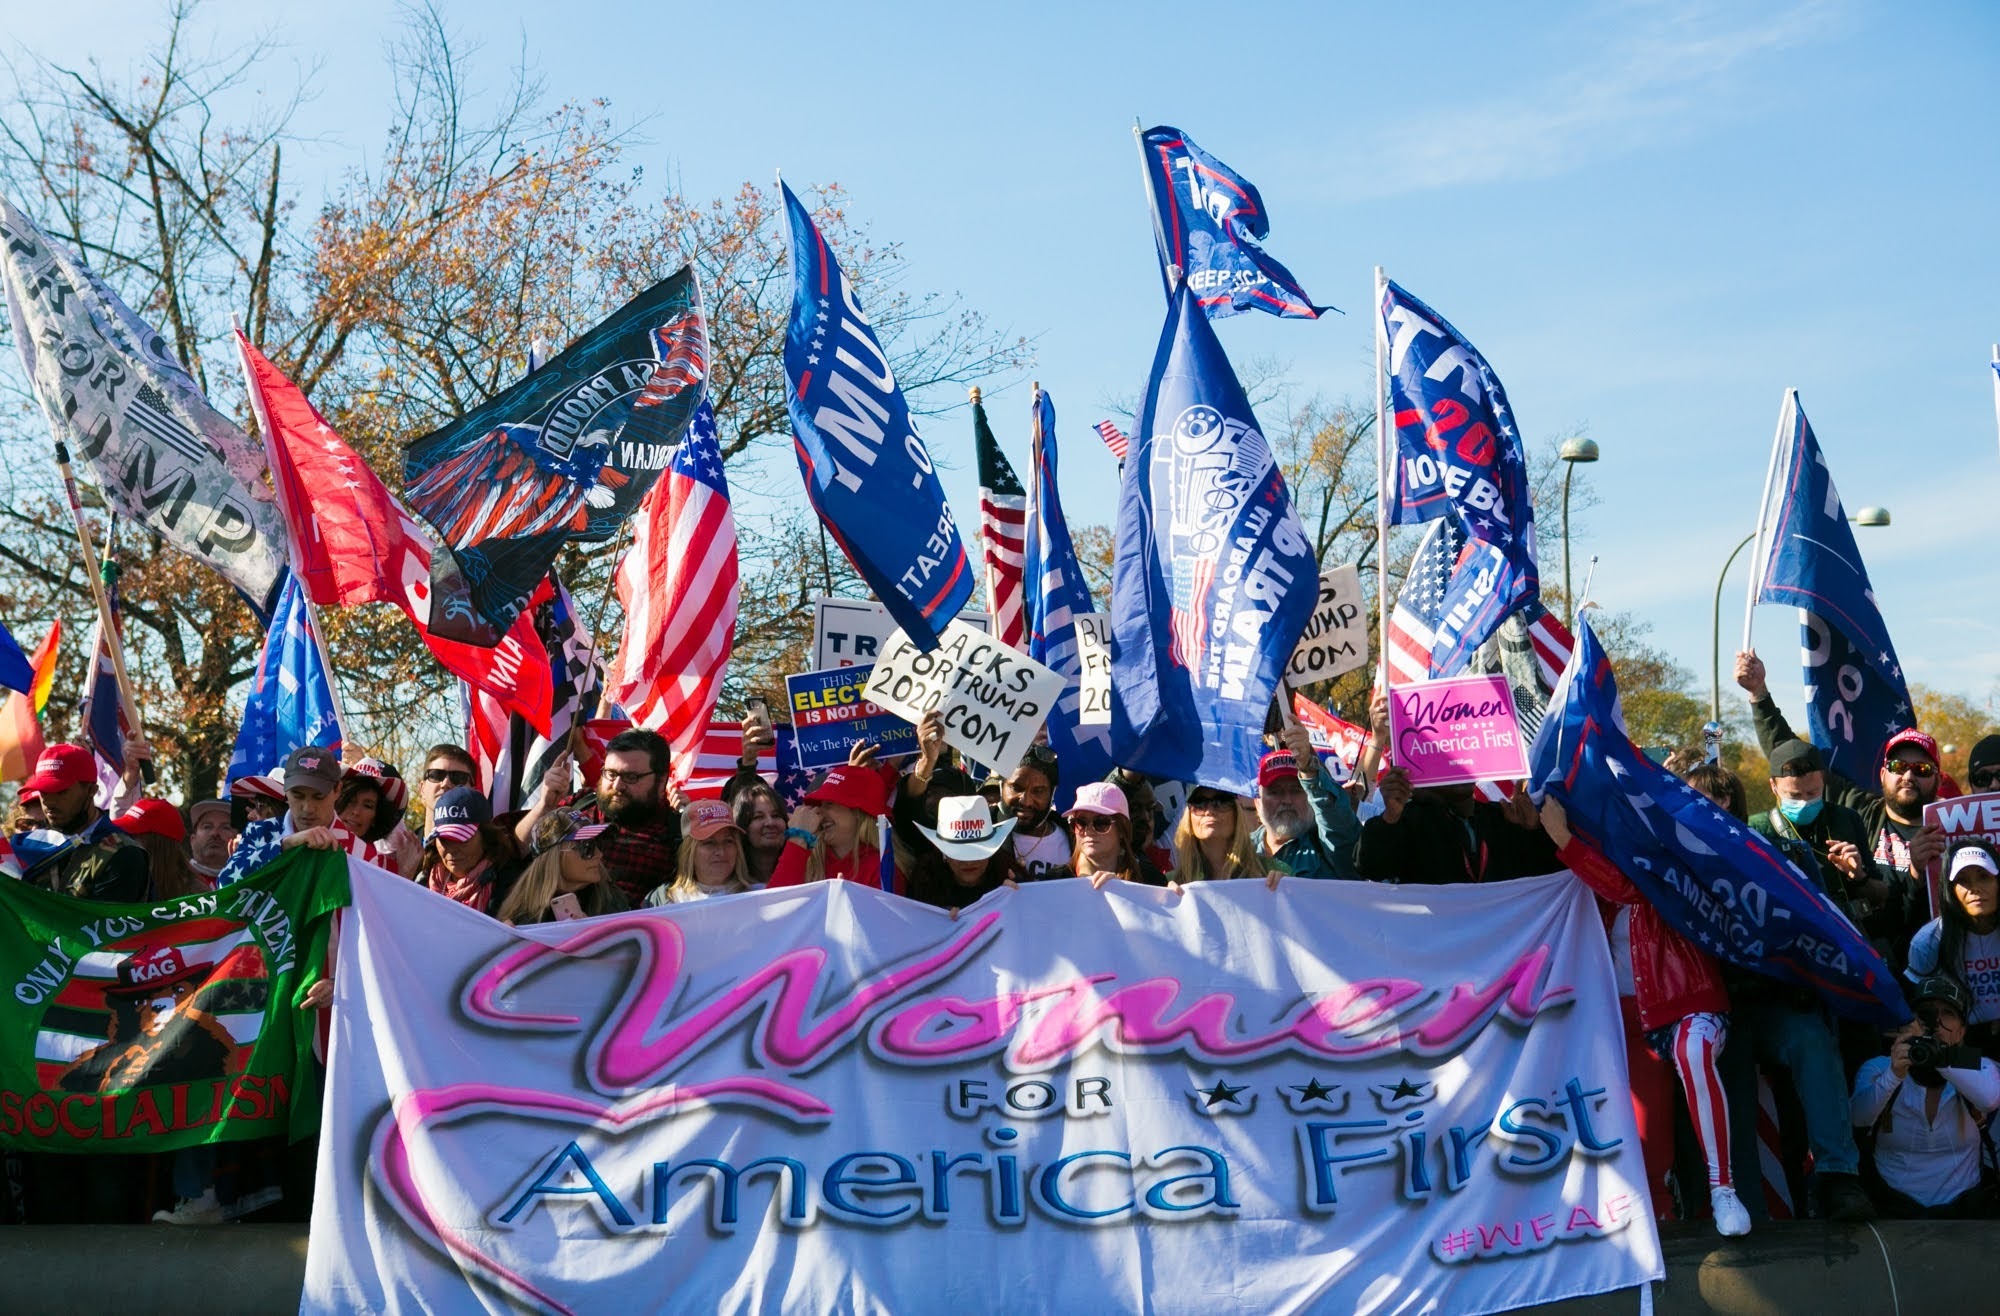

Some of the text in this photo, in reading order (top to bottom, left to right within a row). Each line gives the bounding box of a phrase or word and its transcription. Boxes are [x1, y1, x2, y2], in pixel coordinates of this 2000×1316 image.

[939, 633, 1035, 693] ACKS
[820, 673, 852, 689] THIS
[794, 683, 867, 710] ELECT
[1402, 690, 1507, 726] Women
[806, 710, 821, 723] IS
[826, 705, 859, 720] NOT
[1450, 723, 1467, 732] FOR
[801, 741, 819, 753] We
[820, 739, 841, 751] The
[1409, 729, 1515, 756] America First
[434, 805, 469, 820] MAGA
[950, 818, 985, 831] TRUMP
[1936, 799, 2000, 833] WE
[954, 830, 981, 839] 2020
[1663, 867, 1765, 958] AMERICA
[14, 936, 72, 1006] ONLY
[81, 914, 145, 947] YOU
[151, 894, 219, 920] CAN
[129, 959, 178, 984] KAG
[1963, 957, 2000, 973] FOU
[469, 912, 1574, 1084] Women
[956, 1076, 1115, 1117] FOR
[497, 1073, 1612, 1226] America First
[1441, 1195, 1631, 1255] #WFAF
